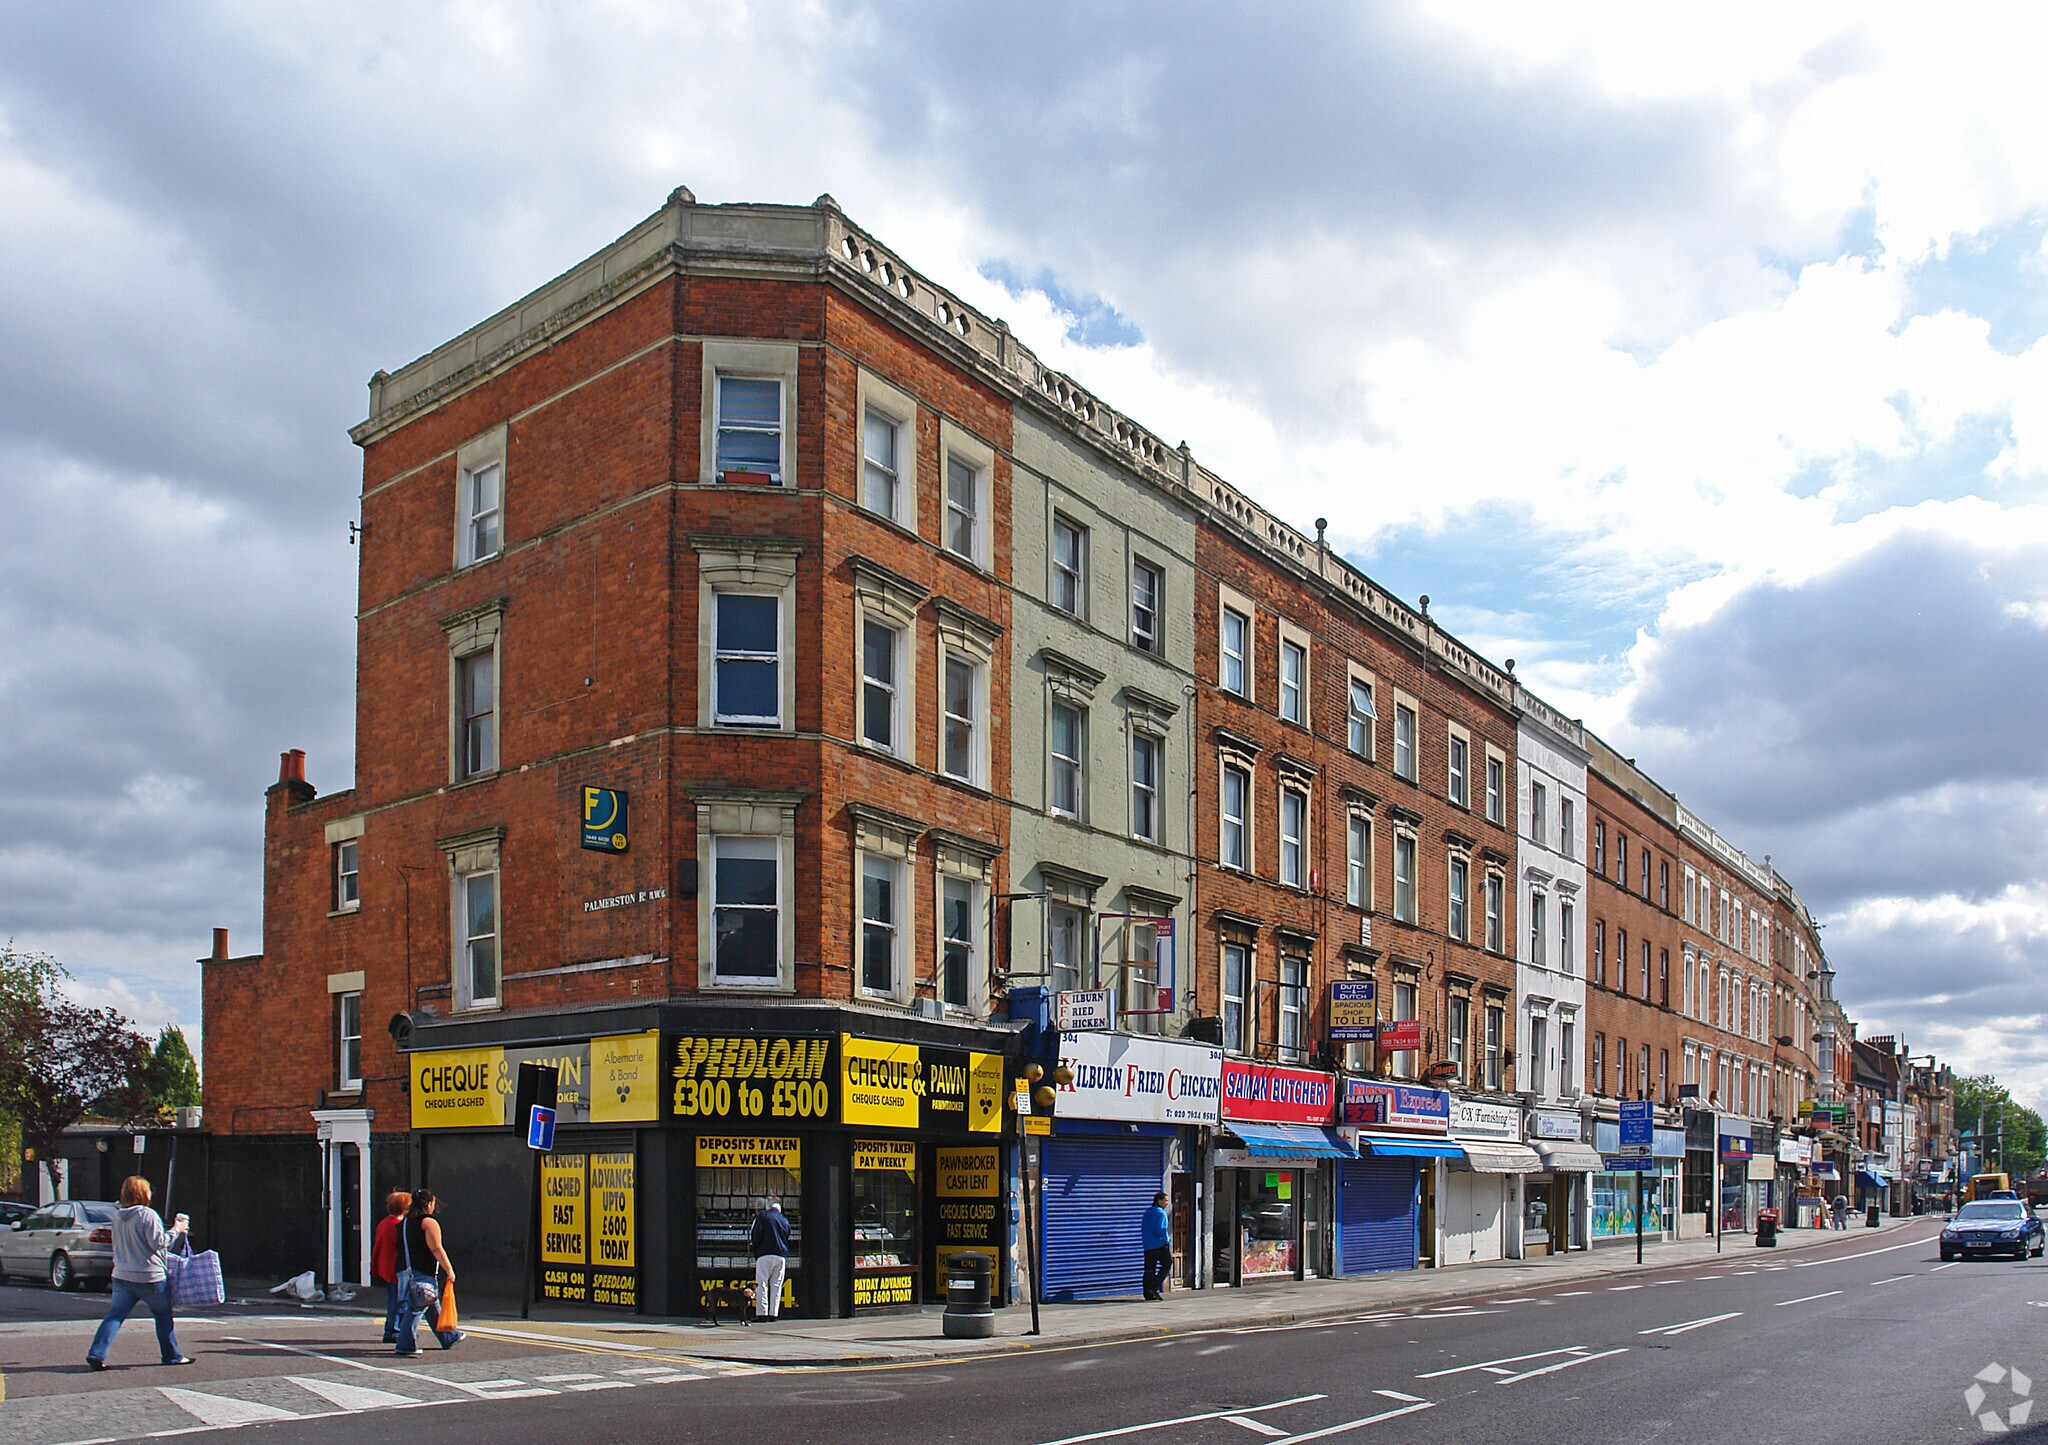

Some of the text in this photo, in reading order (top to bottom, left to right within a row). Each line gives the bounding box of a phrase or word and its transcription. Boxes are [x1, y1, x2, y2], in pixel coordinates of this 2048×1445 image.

[584, 893, 636, 912] PALMERSTON
[1334, 1017, 1372, 1025] TO LET
[1062, 1033, 1078, 1043] 304
[604, 1049, 644, 1064] Albemarle
[672, 1037, 829, 1079] SPEEDLOAN
[1210, 1051, 1221, 1060] 304
[420, 1063, 489, 1094] CHEQUE
[496, 1060, 514, 1094] &
[609, 1067, 638, 1081] & Bond
[848, 1056, 966, 1097] CHEQUE & PAWN
[972, 1065, 1001, 1080] Albemarle
[976, 1082, 997, 1095] & Bond
[1125, 1064, 1165, 1097] FRIED
[1167, 1068, 1219, 1100] CHICKEN
[1225, 1072, 1268, 1101] SAMAN
[1271, 1077, 1330, 1106] BUTCHERY
[425, 1097, 485, 1109] CHEQUES CASHED
[673, 1079, 829, 1117] £300 to £500
[852, 1093, 964, 1112] CHEQUES CASHED PAWNBROKER
[1346, 1095, 1384, 1104] NAVA
[1400, 1089, 1442, 1115] Express
[1174, 1110, 1185, 1118] 020
[1475, 1108, 1508, 1127] Furnishing
[700, 1138, 797, 1151] DEPOSITS TAKEN
[853, 1141, 914, 1154] DEPOSITS TAKEN
[711, 1153, 786, 1165] PAY WEEKLY
[860, 1156, 907, 1168] PAY WEEKLY
[940, 1155, 996, 1170] PAWNBROKER
[546, 1177, 581, 1197] CASHED
[947, 1175, 989, 1190] CASH LENT
[602, 1192, 626, 1212] UPTO
[553, 1205, 574, 1225] FAST
[940, 1204, 996, 1220] CHEQUES CASHED
[602, 1215, 627, 1237] £600
[946, 1224, 988, 1239] FAST SERVICE
[546, 1233, 582, 1254] SERVICE
[600, 1239, 630, 1261] TODAY
[545, 1271, 585, 1285] CASH ON
[854, 1276, 912, 1292] PAYDAY ADVANCES
[544, 1285, 586, 1300] THE SPOT
[594, 1290, 610, 1303] £300
[611, 1291, 619, 1304] to
[854, 1289, 912, 1305] UPTO £600 TODAY
